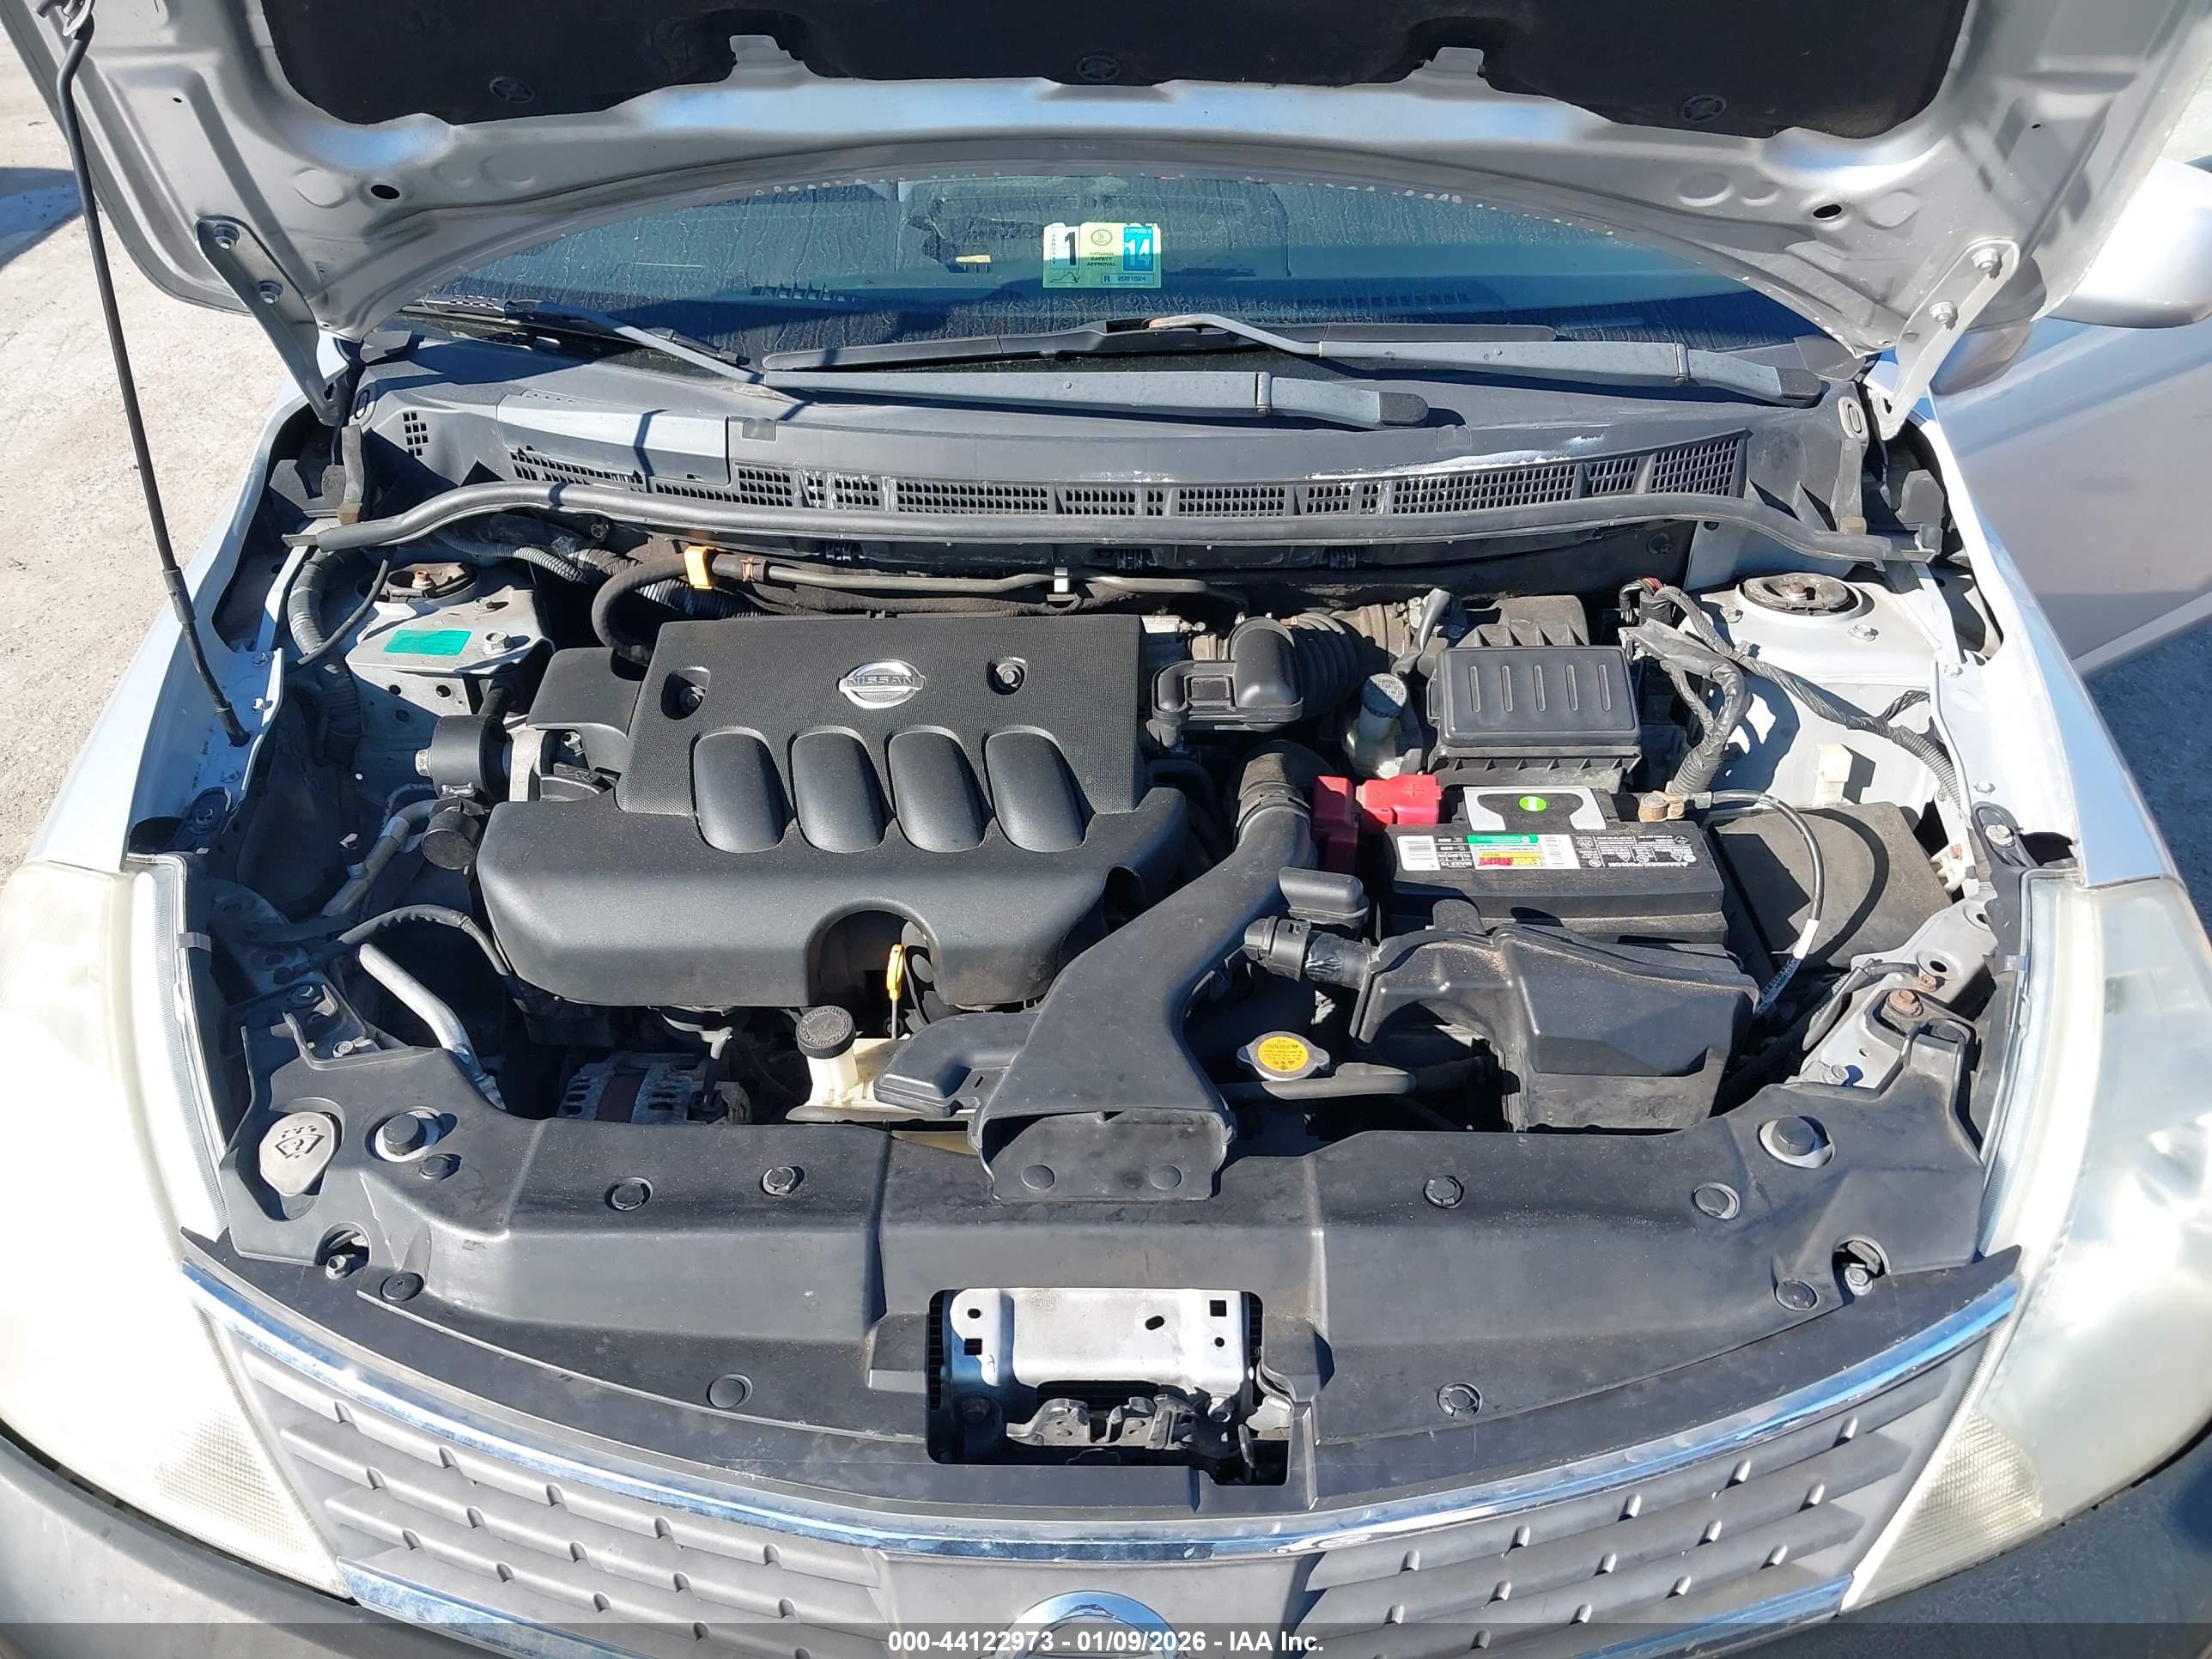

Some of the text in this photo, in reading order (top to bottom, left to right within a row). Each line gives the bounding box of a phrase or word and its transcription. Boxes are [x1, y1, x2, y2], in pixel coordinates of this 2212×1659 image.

[1064, 231, 1077, 266] 1
[1123, 237, 1152, 267] 14
[847, 675, 915, 686] NISSAN
